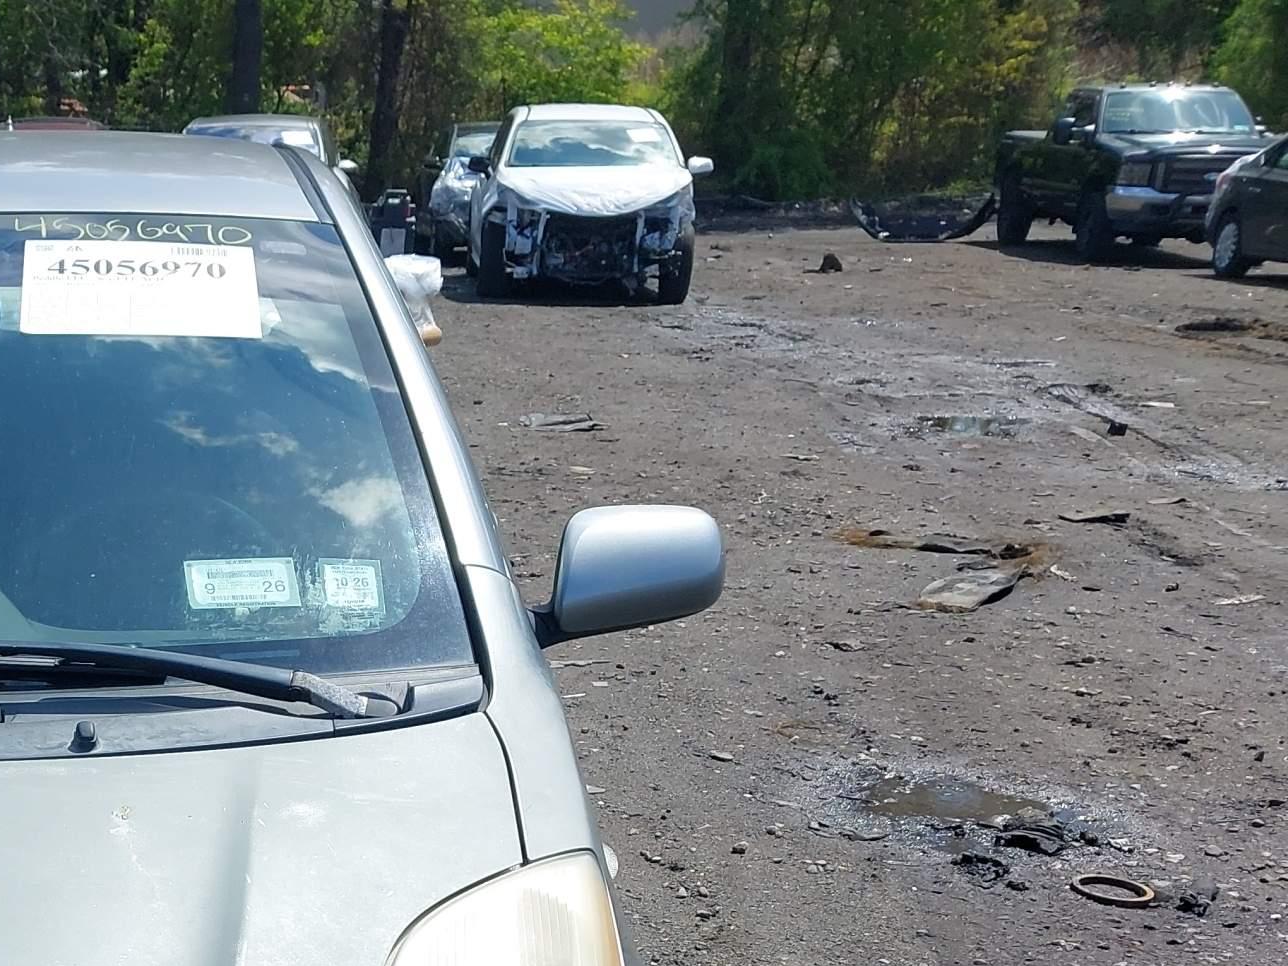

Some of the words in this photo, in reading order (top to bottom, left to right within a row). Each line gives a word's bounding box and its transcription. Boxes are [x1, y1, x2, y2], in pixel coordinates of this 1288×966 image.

[14, 215, 253, 245] 45056970
[46, 258, 227, 280] 45056970
[204, 582, 216, 595] 9
[262, 580, 286, 593] 26
[353, 577, 369, 588] 26
